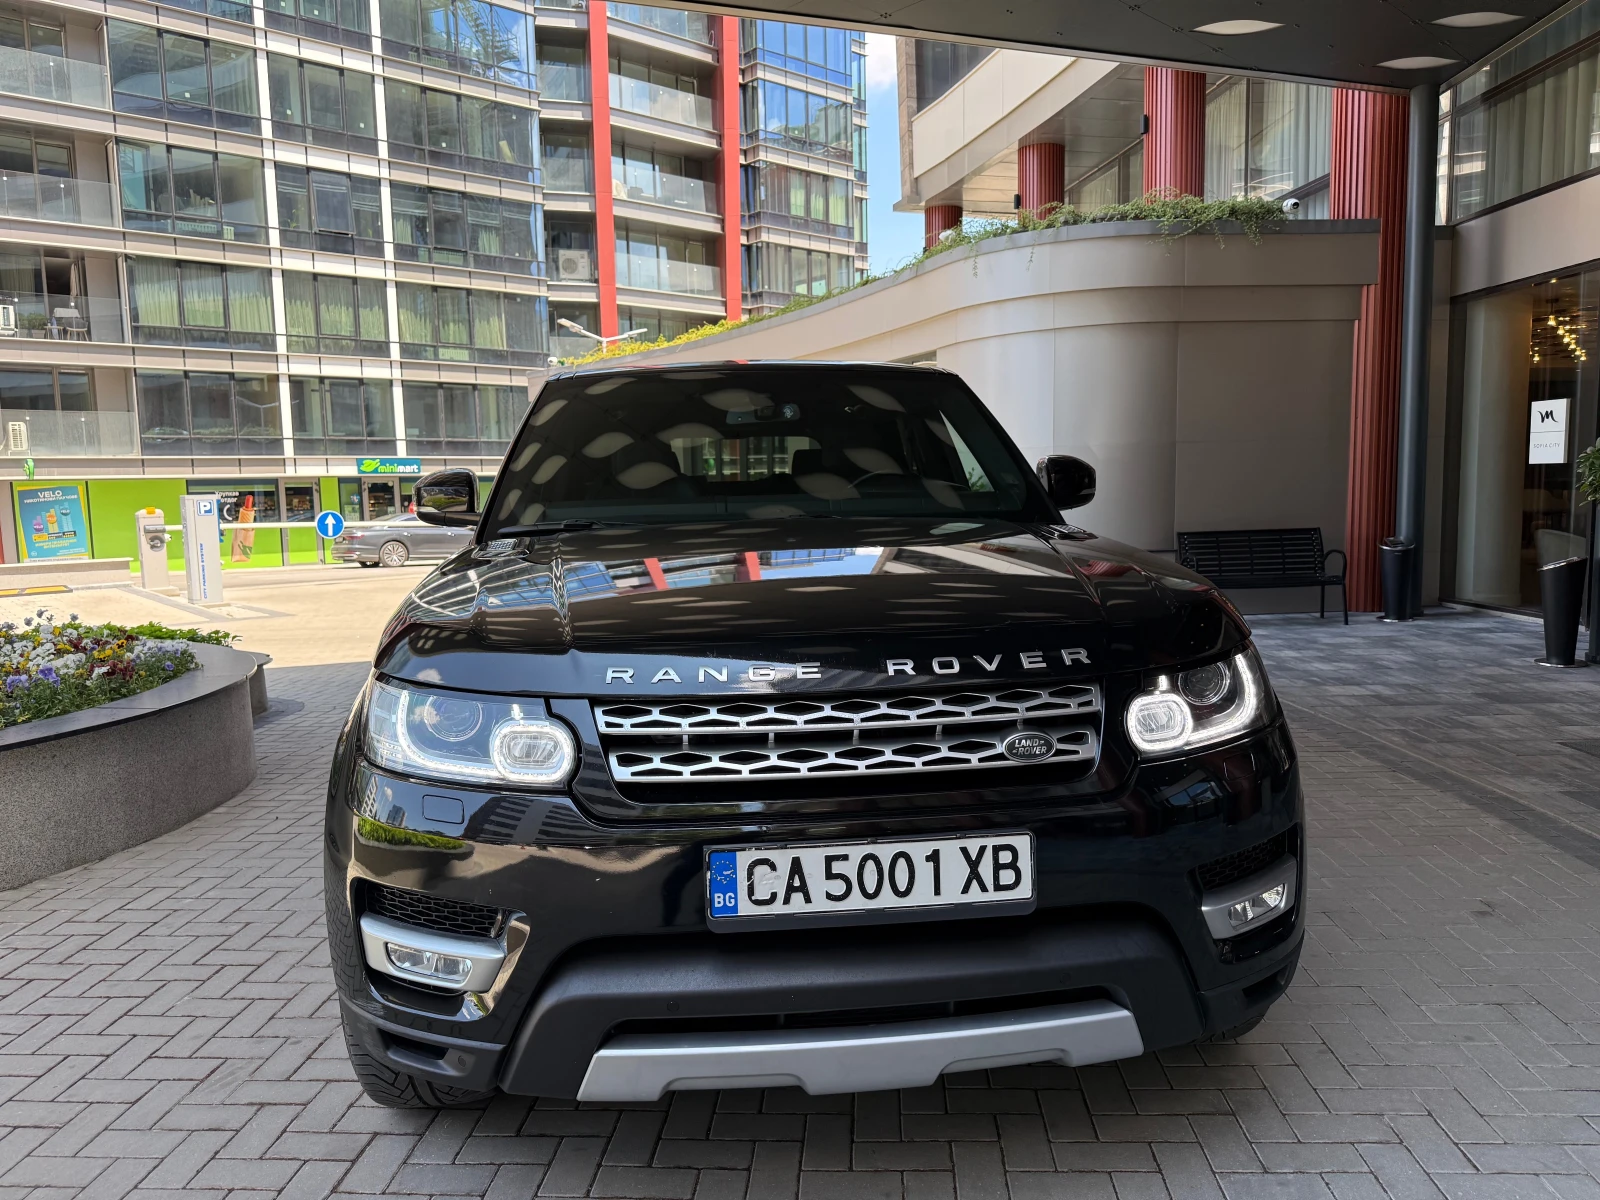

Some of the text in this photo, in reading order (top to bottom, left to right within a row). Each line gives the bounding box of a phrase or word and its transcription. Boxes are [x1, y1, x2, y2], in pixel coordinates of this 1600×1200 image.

[378, 463, 419, 473] minimart
[38, 490, 62, 498] VELO
[199, 501, 211, 515] P
[605, 648, 1092, 684] RANGE ROVER
[1015, 739, 1039, 748] LAND
[1017, 746, 1047, 756] ROVER
[747, 843, 1022, 906] CA 5001 XB
[714, 893, 736, 908] BG
